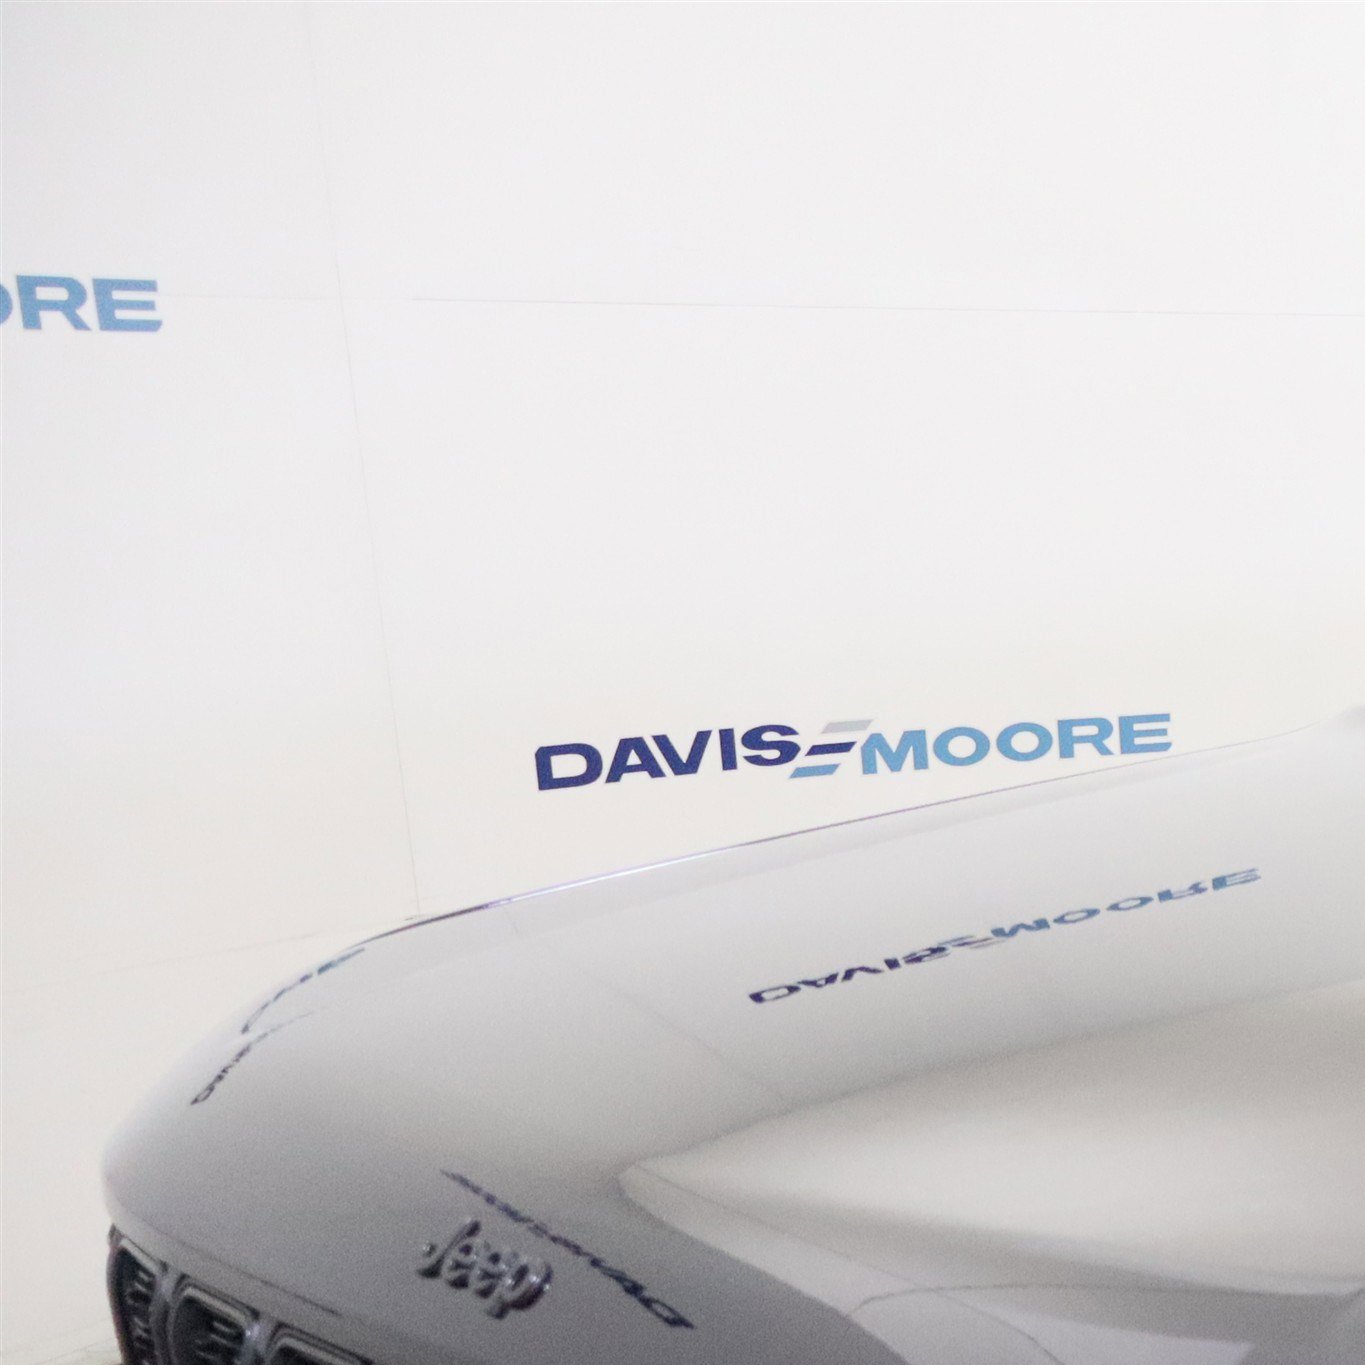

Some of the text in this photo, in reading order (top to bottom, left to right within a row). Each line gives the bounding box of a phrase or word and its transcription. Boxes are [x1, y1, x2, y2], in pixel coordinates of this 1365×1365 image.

[0, 275, 163, 332] RE
[534, 713, 1173, 791] DAVIS MOORE
[416, 1219, 554, 1320] Jeep
